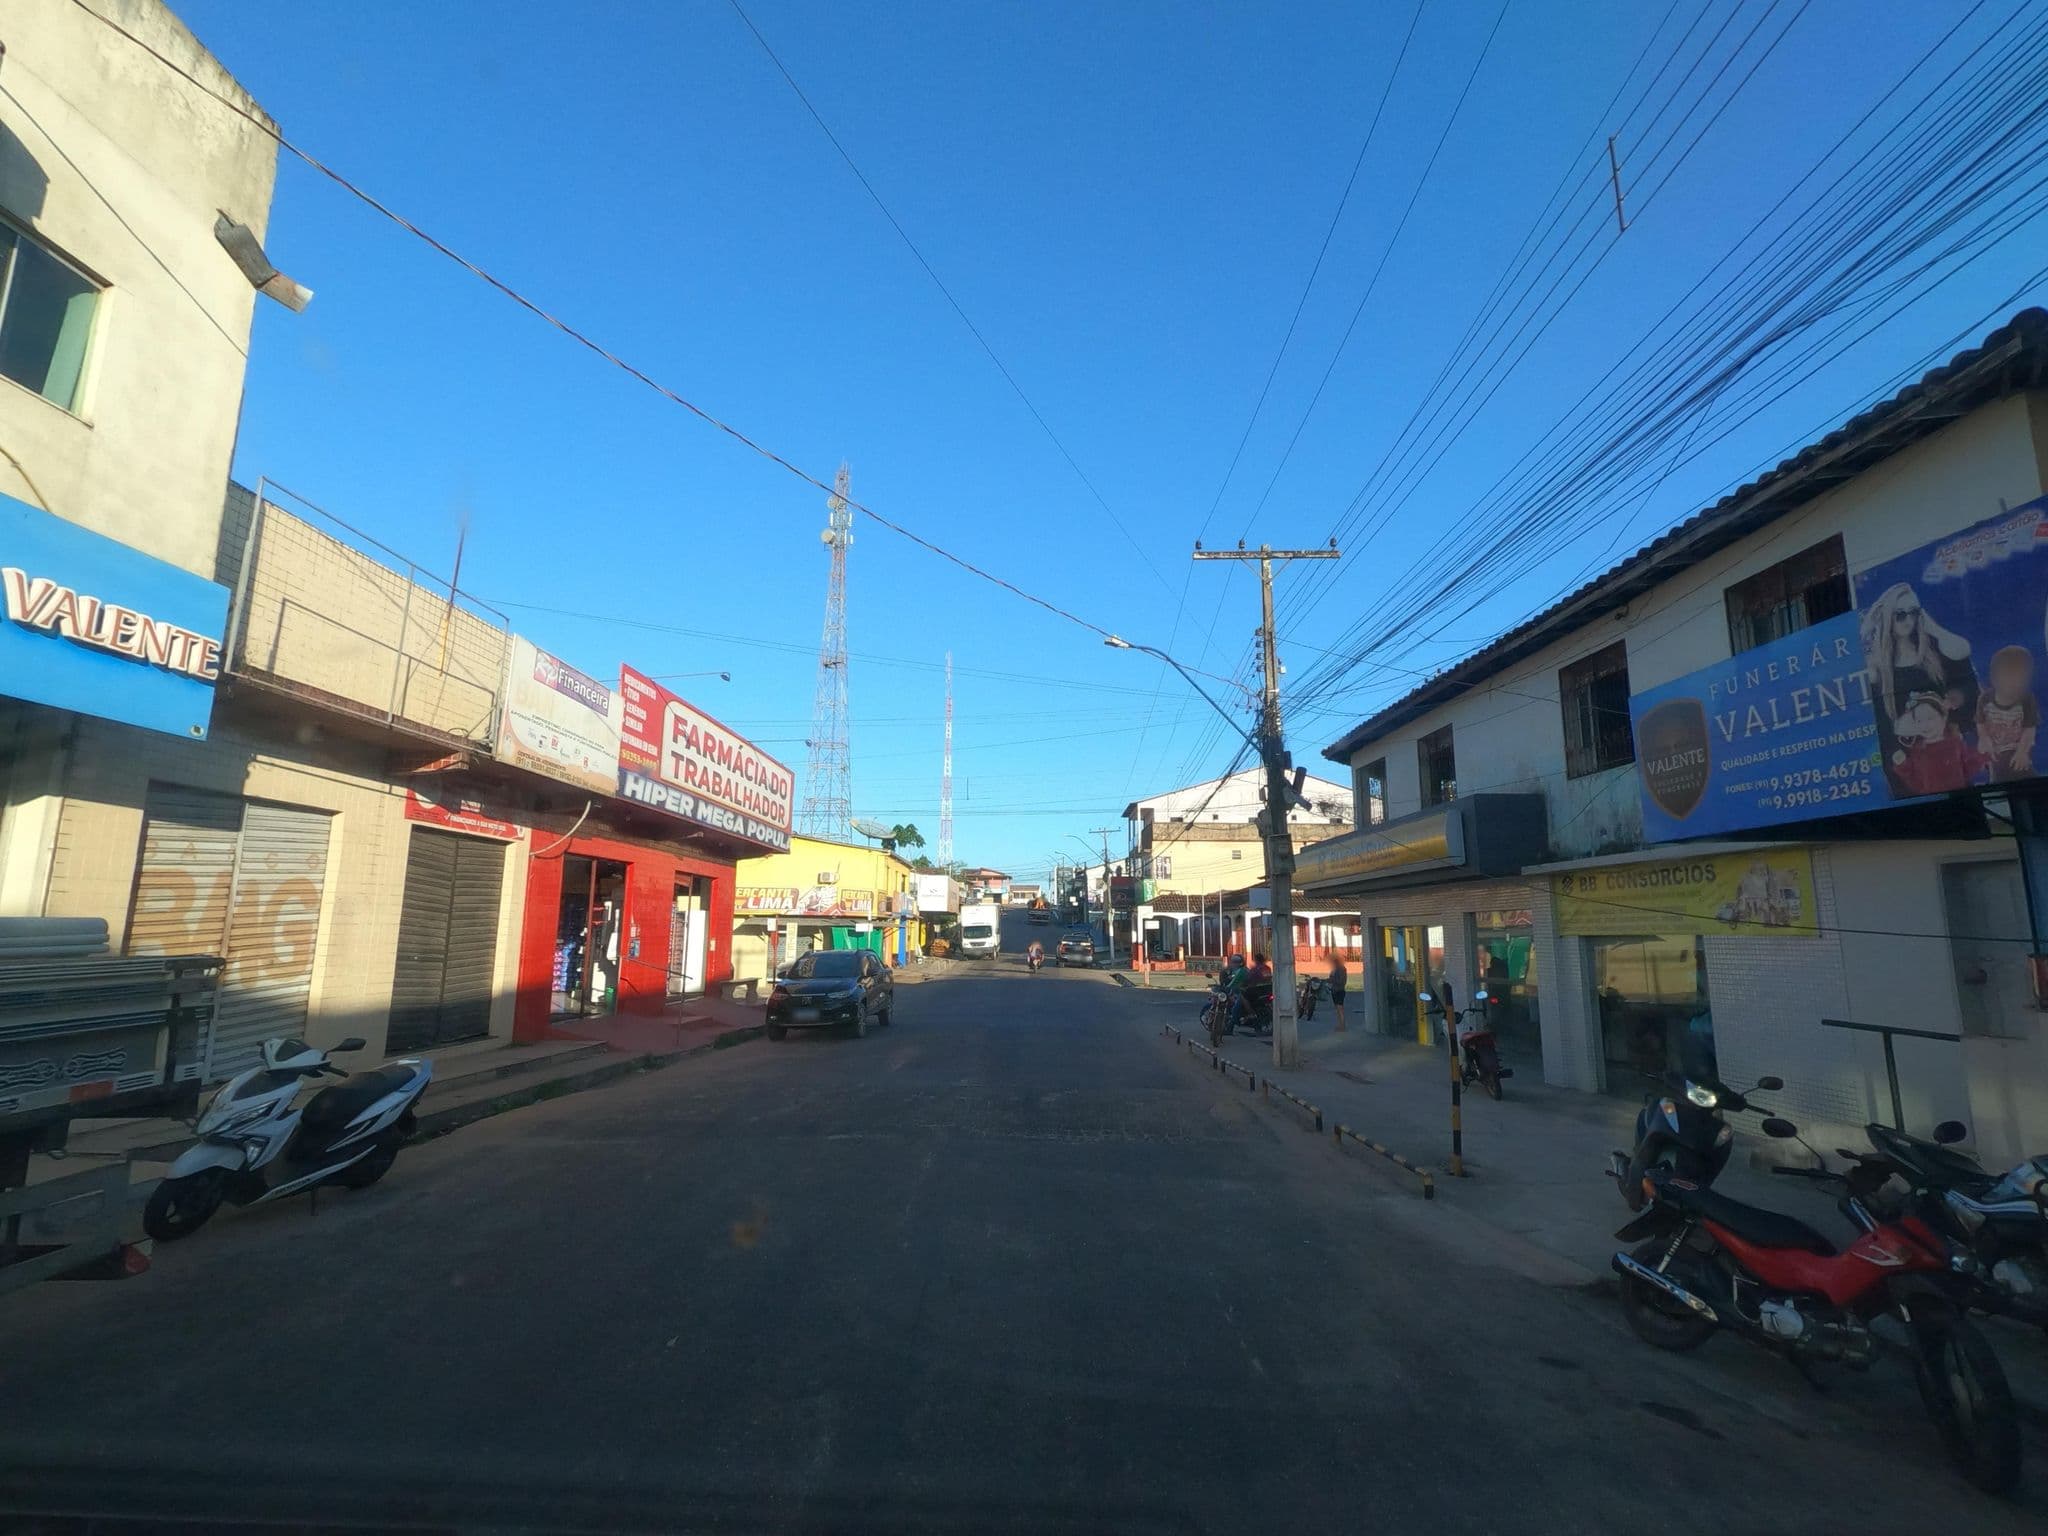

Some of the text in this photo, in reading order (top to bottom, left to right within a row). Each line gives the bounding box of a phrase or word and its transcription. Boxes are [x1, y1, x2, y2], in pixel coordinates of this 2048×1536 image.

[2, 567, 220, 680] VALENTE
[558, 668, 609, 710] Financeira
[1709, 637, 1850, 701] FUNERÁR
[1714, 669, 1873, 743] VALENT
[672, 713, 768, 791] FARMÁCIA
[768, 774, 788, 800] DO
[1647, 748, 1705, 775] VALENTE
[1721, 724, 1878, 771] QUALIDADE E RESPEITO NA DESP
[671, 750, 785, 826] TRABALHADOR
[1770, 758, 1871, 792] 9.9378-4678
[1773, 779, 1872, 809] 9.9918-2345
[624, 773, 694, 819] HIPER
[696, 800, 746, 835] MEGA
[736, 888, 794, 898] ERCANTIL
[747, 897, 794, 909] LIMA
[1579, 874, 1597, 893] BB
